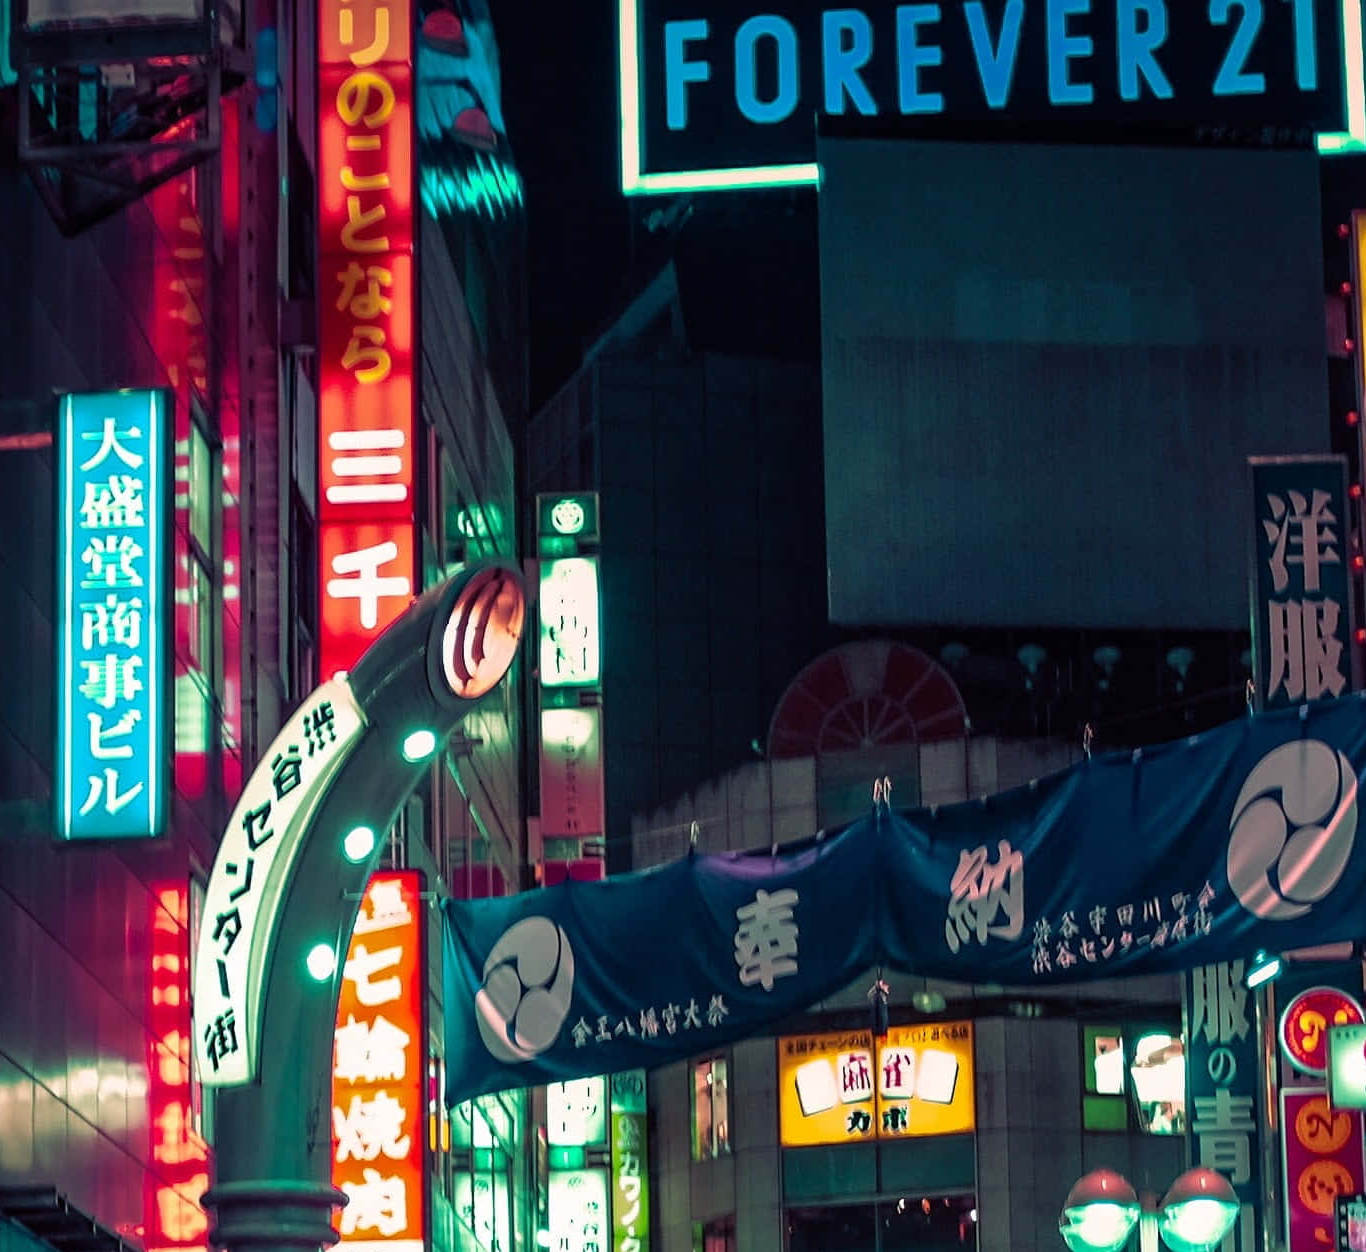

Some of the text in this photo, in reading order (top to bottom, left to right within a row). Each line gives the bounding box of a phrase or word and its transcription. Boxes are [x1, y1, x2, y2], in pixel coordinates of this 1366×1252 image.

[665, 0, 1318, 131] FOREVER 21
[79, 416, 145, 818] 大盛堂商事ビル
[202, 699, 339, 1073] 渋谷センター街
